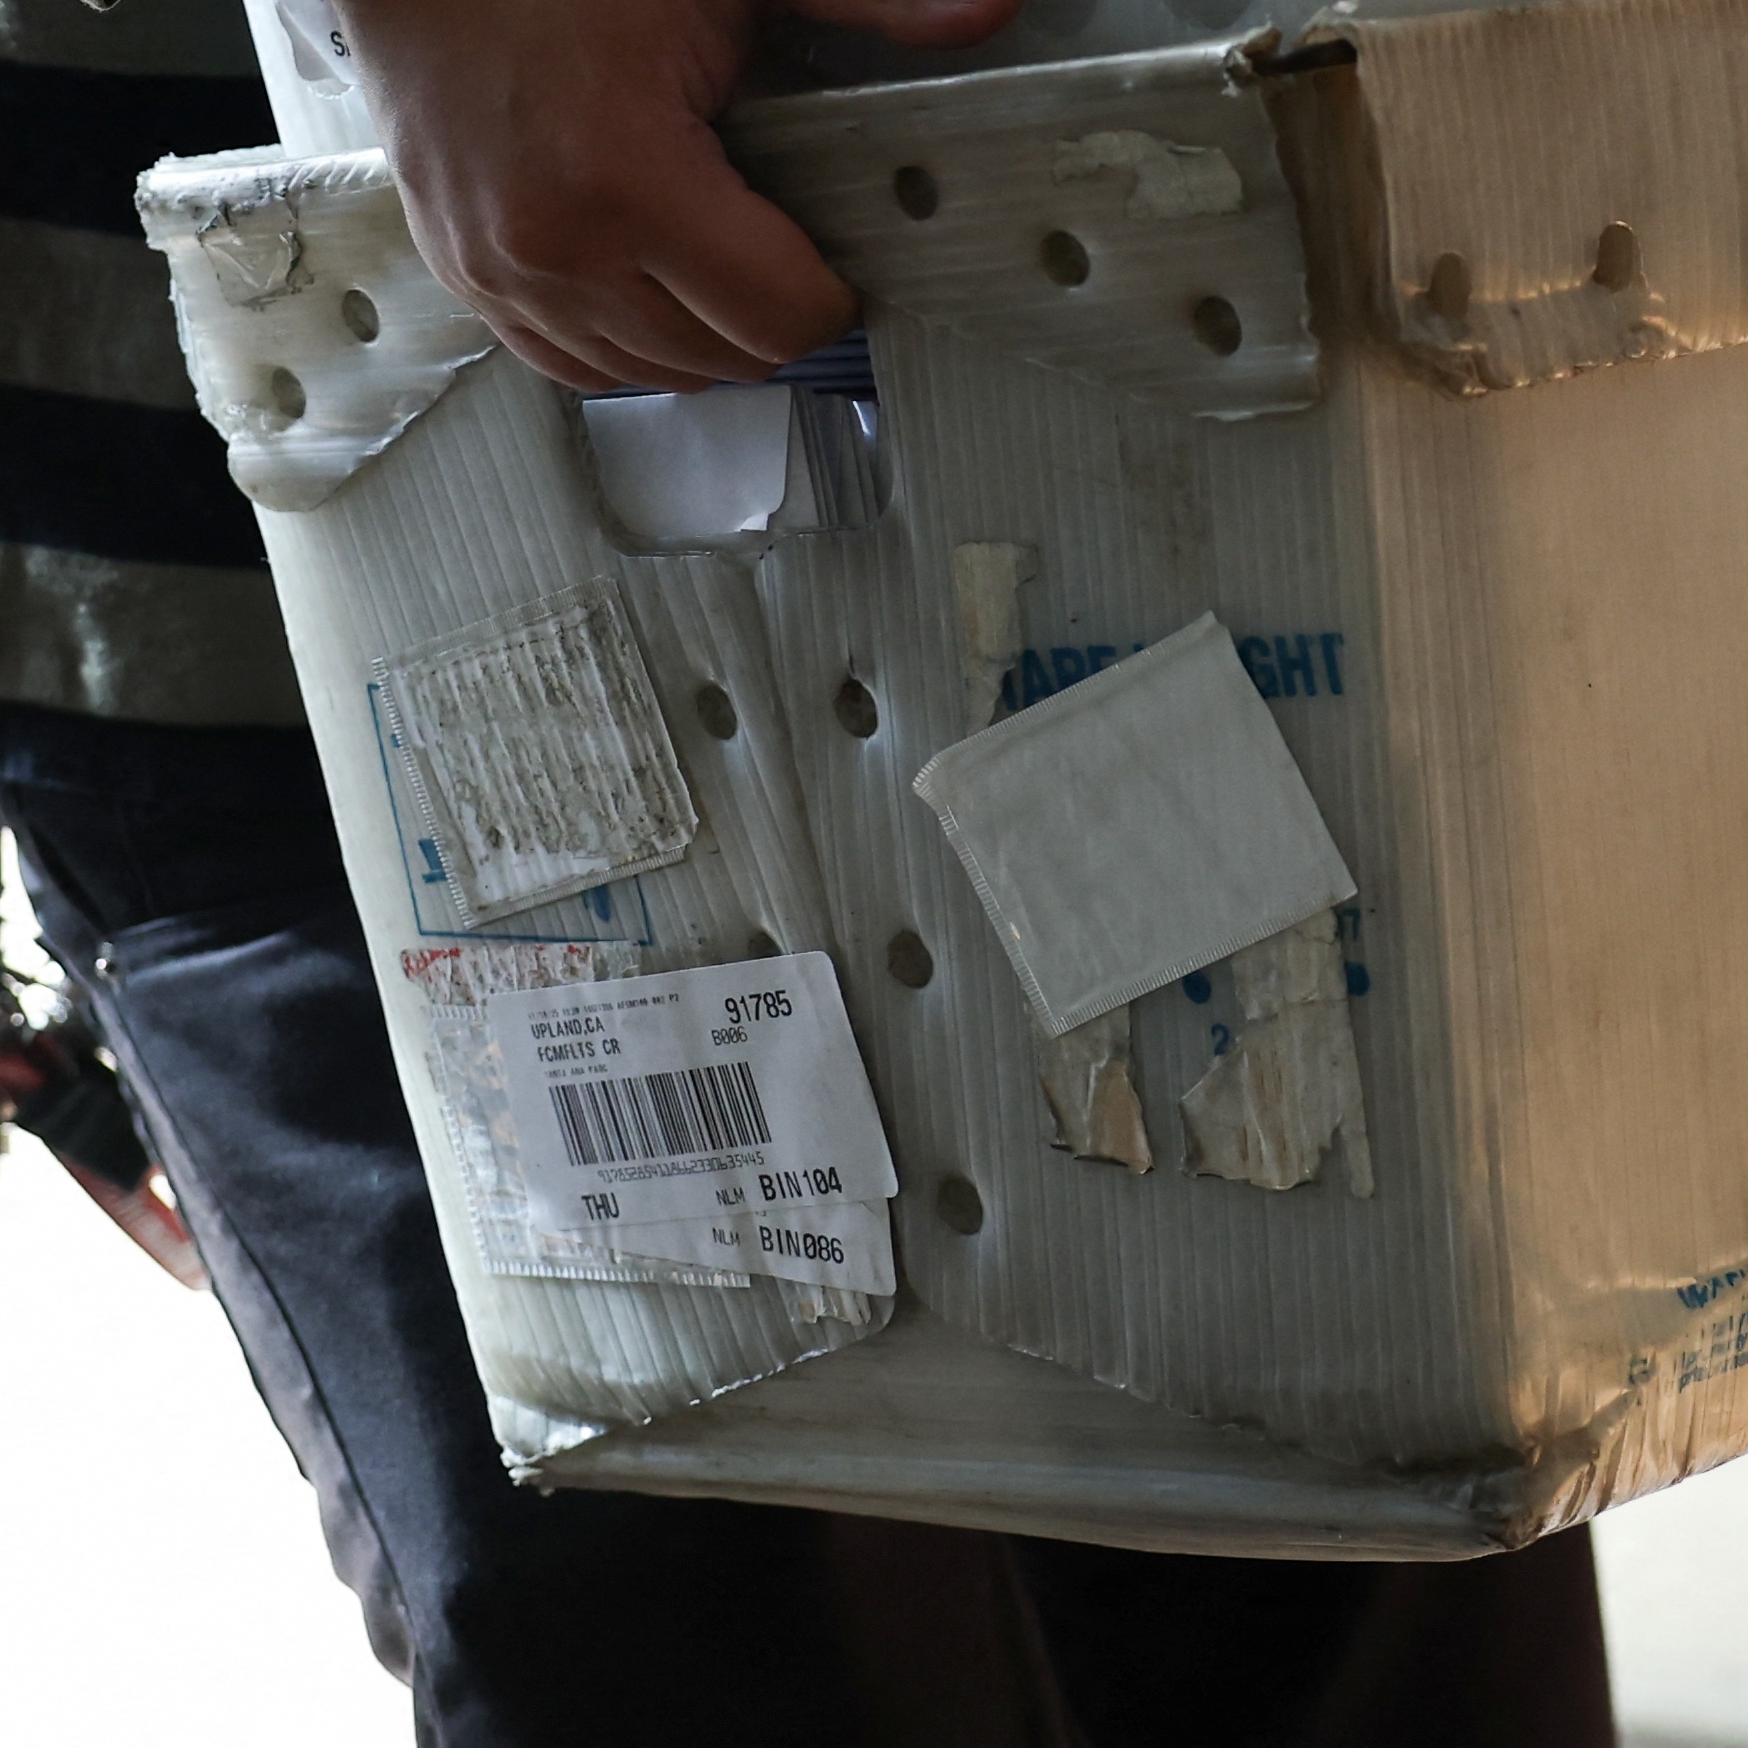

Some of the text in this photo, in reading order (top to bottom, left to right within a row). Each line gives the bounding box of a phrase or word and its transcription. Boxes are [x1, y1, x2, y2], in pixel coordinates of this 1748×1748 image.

[531, 1015, 606, 1040] UPLAND,CA
[724, 990, 793, 1024] 91785
[602, 1038, 622, 1055] CR
[581, 1191, 621, 1221] THU
[715, 1187, 746, 1207] NLM
[712, 1227, 741, 1247] NLM
